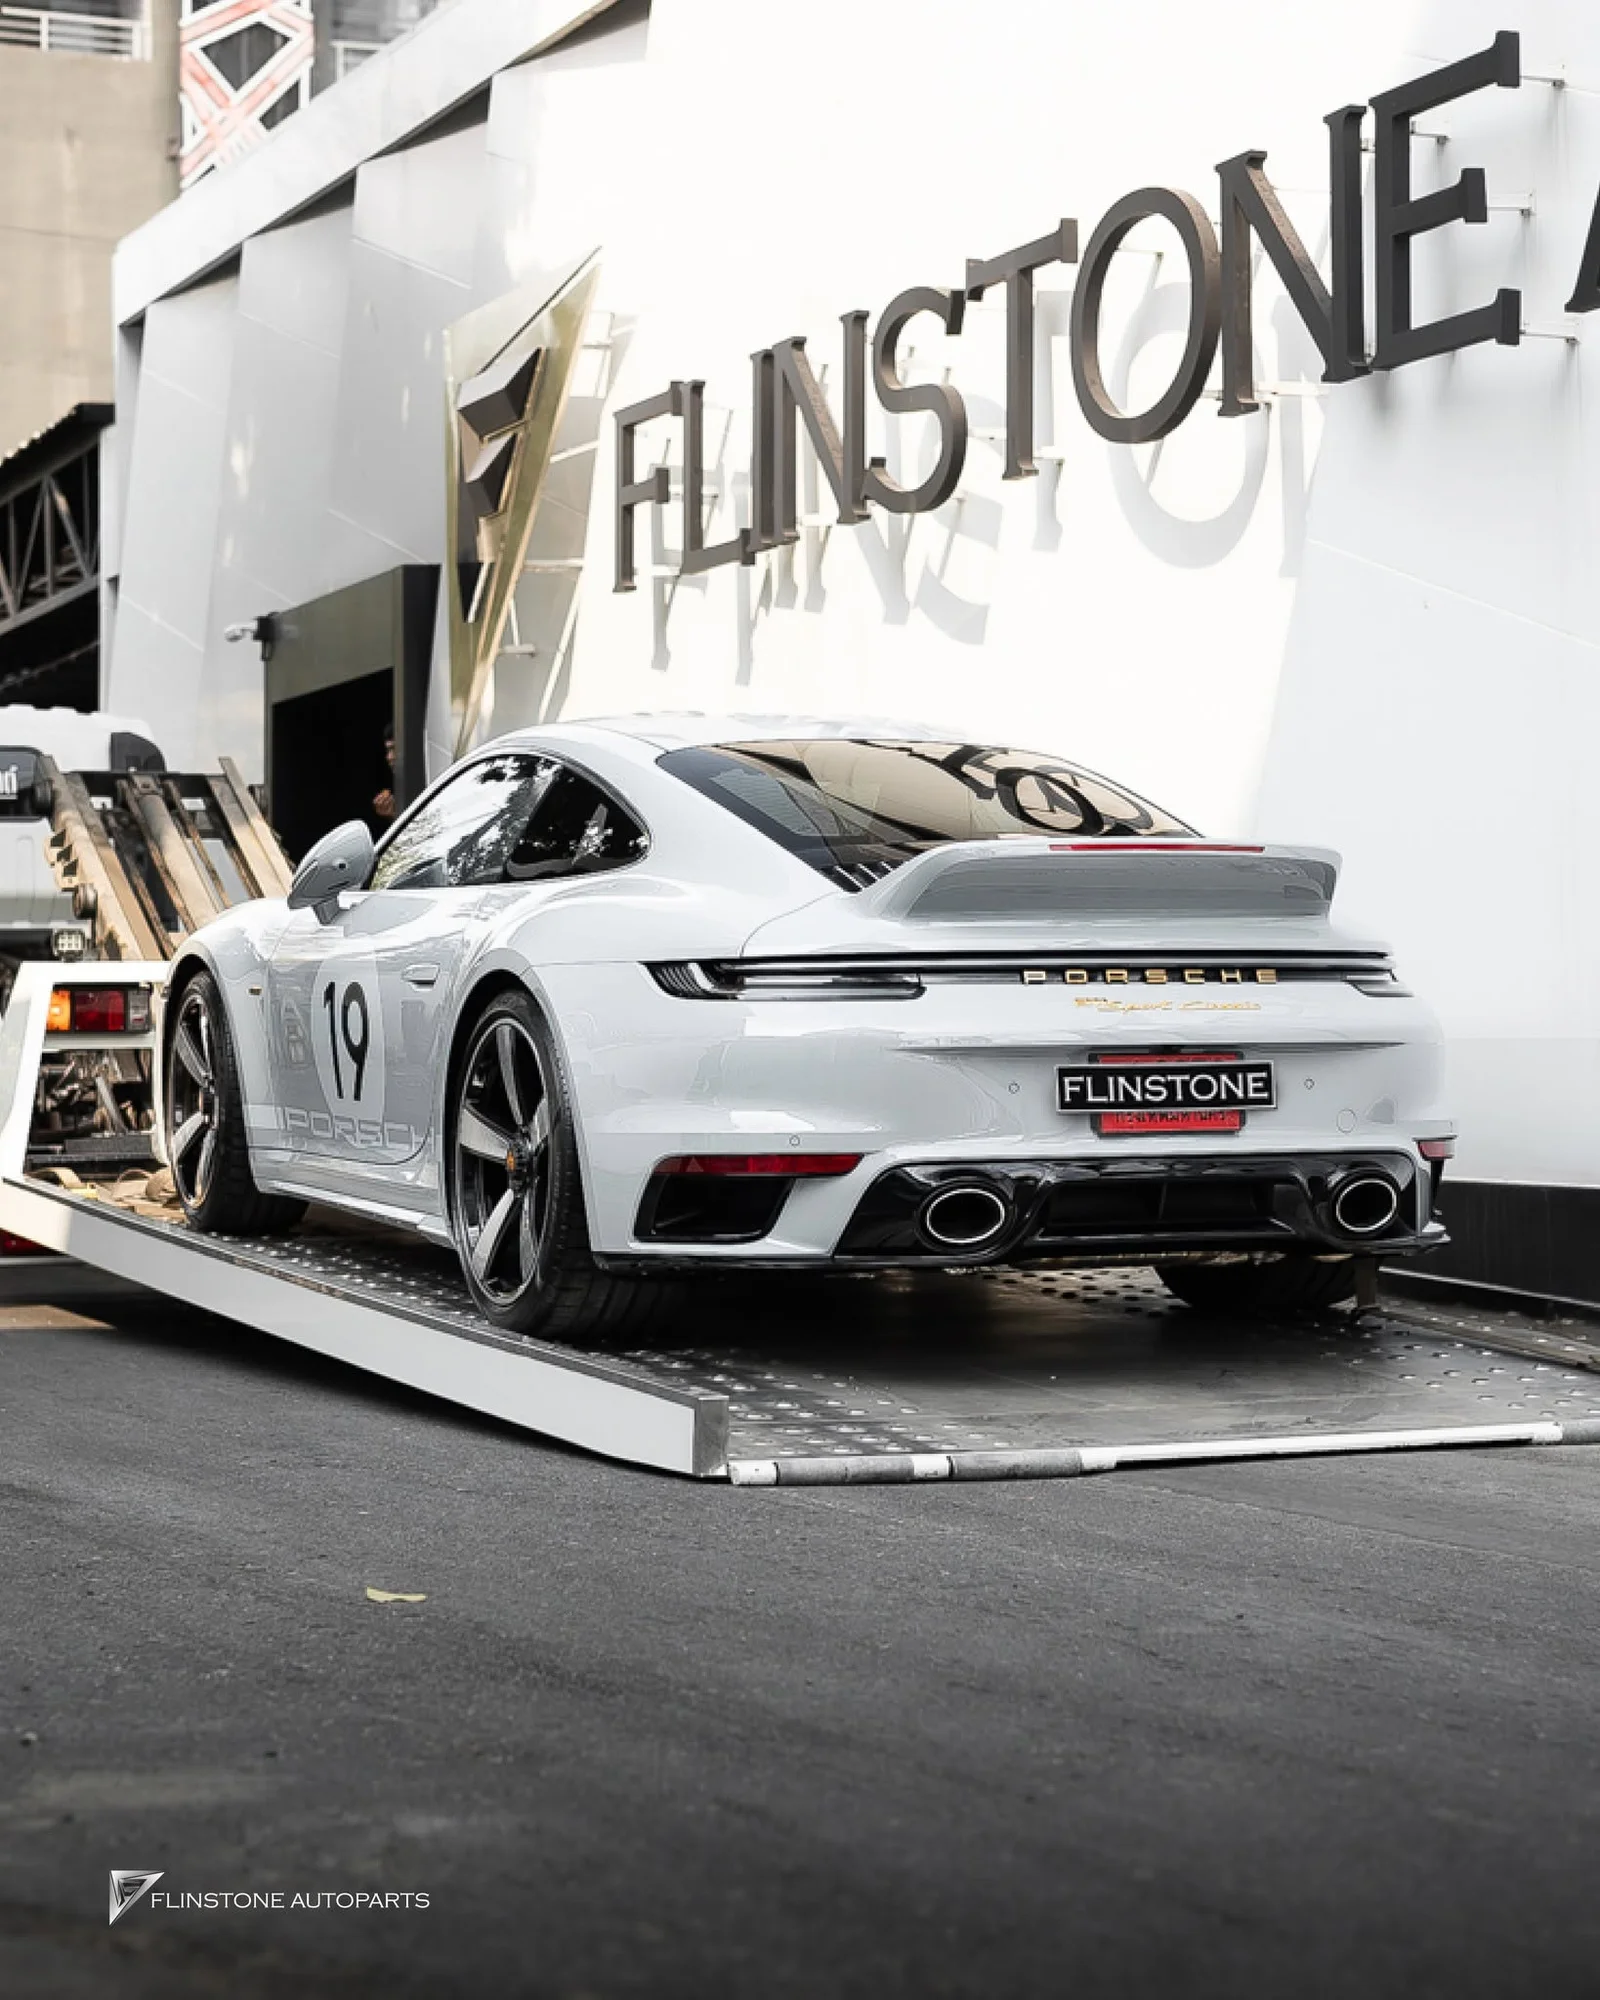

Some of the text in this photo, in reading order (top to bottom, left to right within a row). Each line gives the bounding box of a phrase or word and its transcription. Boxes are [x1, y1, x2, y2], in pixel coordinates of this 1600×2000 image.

[613, 30, 1521, 593] FLINSTONE
[1023, 968, 1278, 985] PORSCHE
[323, 981, 370, 1102] 19
[1062, 1072, 1269, 1102] FLINSTONE
[284, 1107, 436, 1150] PORSCH
